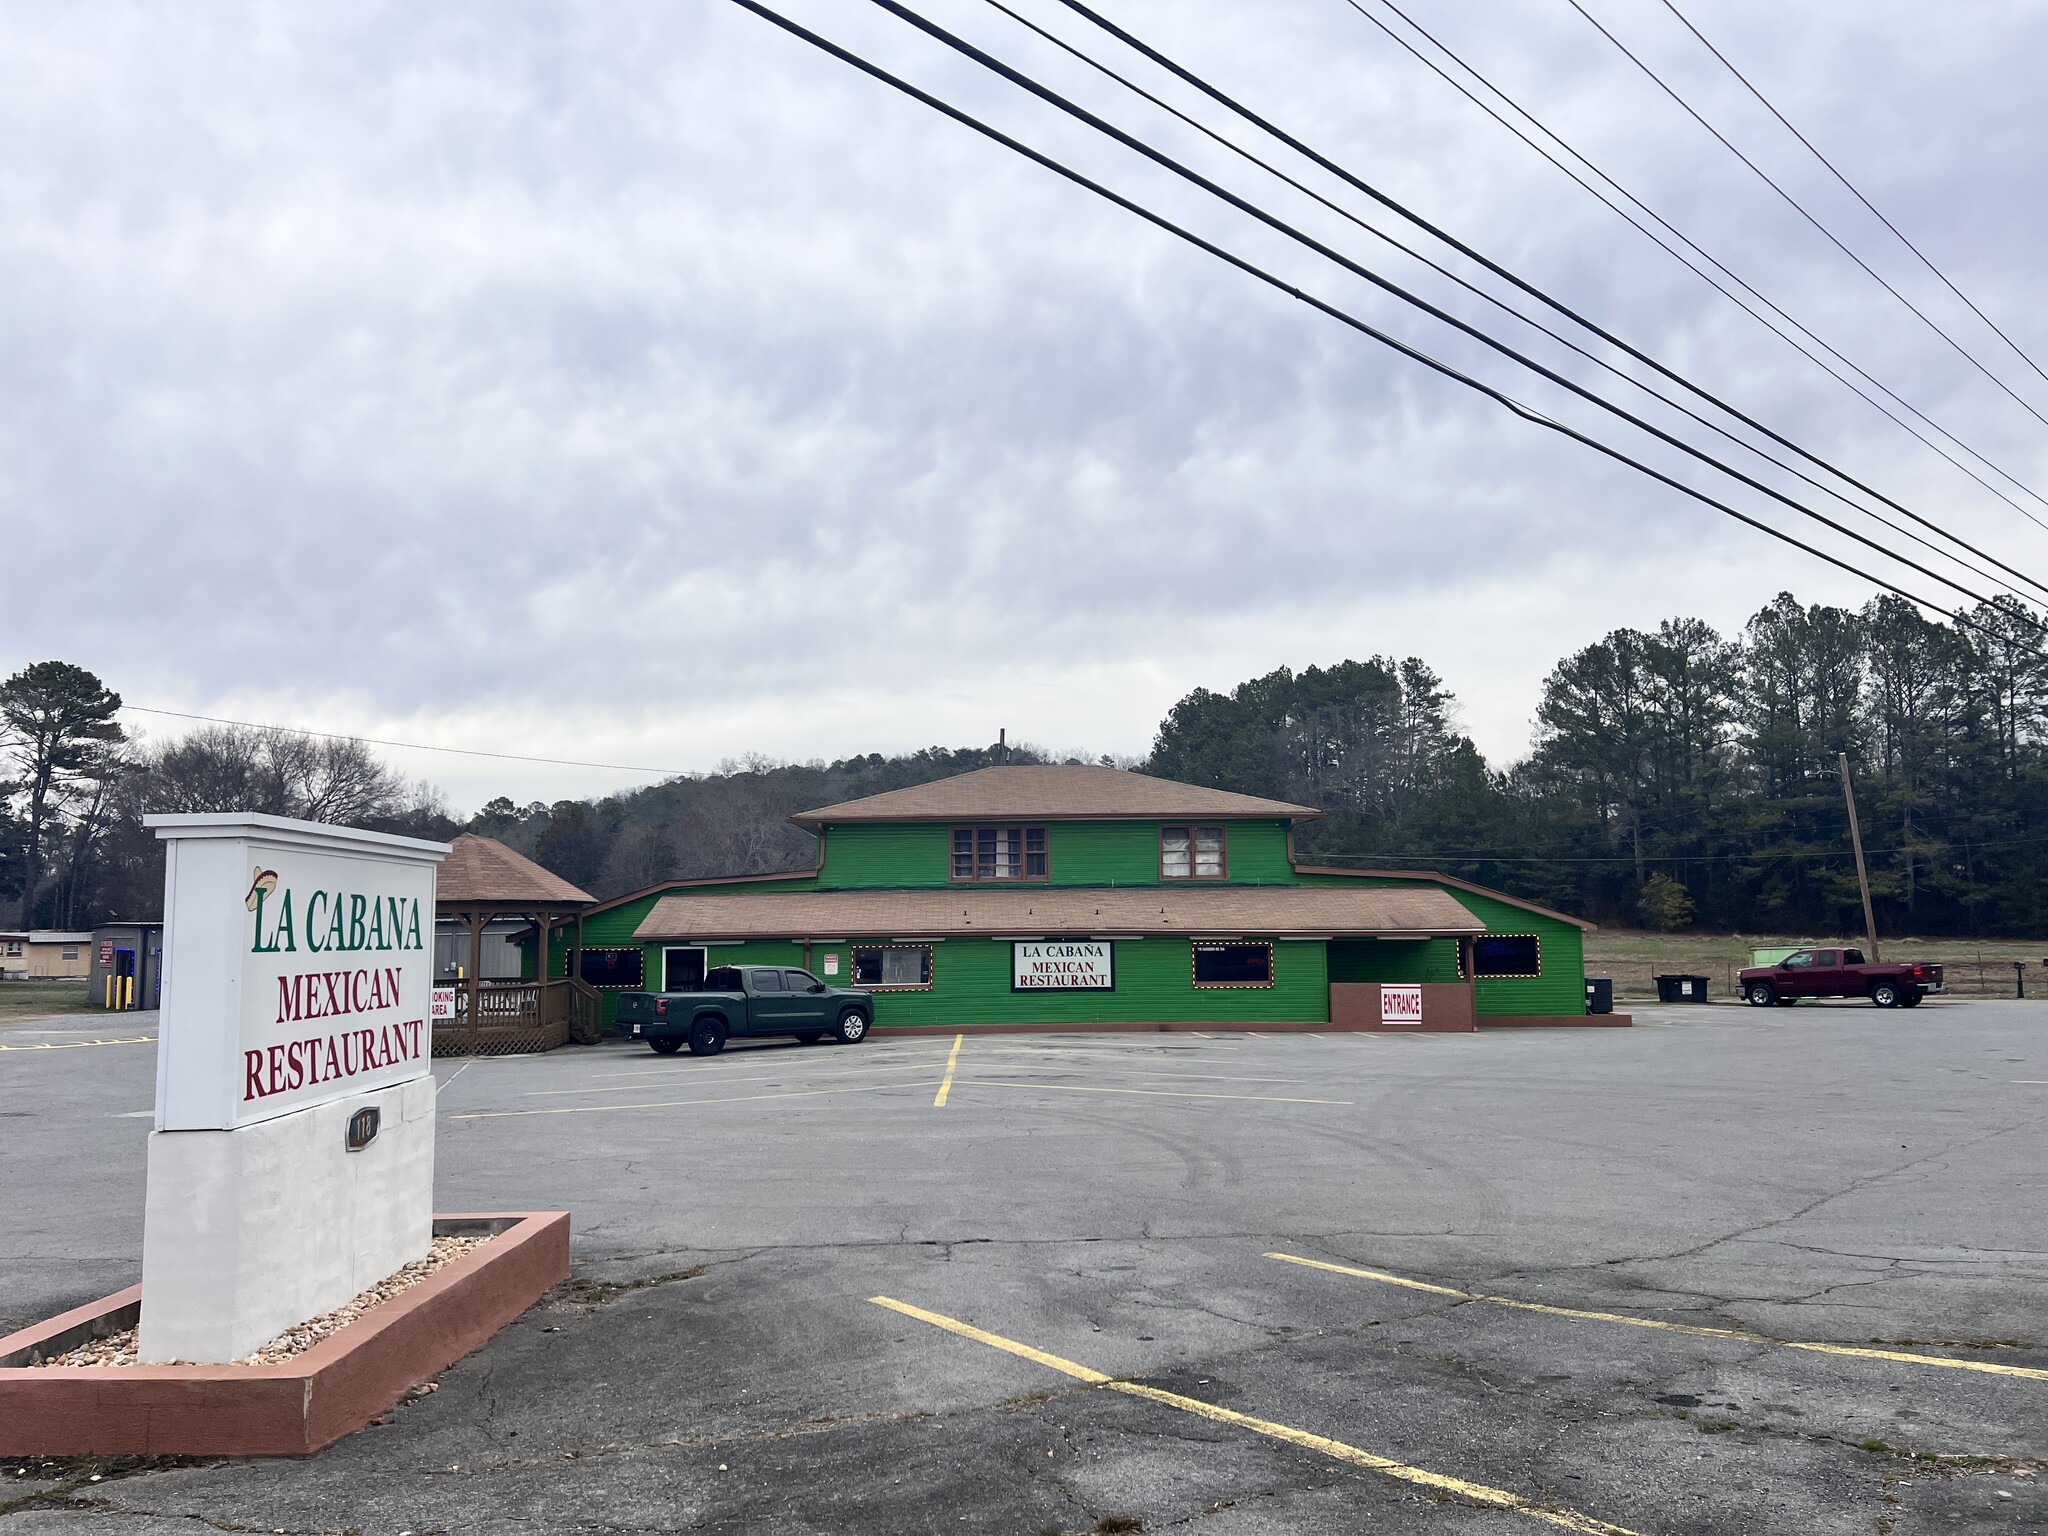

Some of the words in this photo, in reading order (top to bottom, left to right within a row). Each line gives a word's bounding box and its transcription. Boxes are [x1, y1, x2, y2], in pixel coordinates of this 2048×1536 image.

[251, 887, 297, 953] LA
[306, 889, 423, 953] CABANA
[1022, 946, 1041, 957] LA
[1046, 944, 1104, 957] CABAÑA
[1032, 962, 1094, 973] MEXICAN
[1020, 975, 1107, 986] RESTAURANT
[276, 967, 402, 1024] MEXICAN
[1383, 993, 1420, 1014] ENTRANCE
[243, 1019, 423, 1101] RESTAURANT
[357, 1115, 371, 1140] 118
